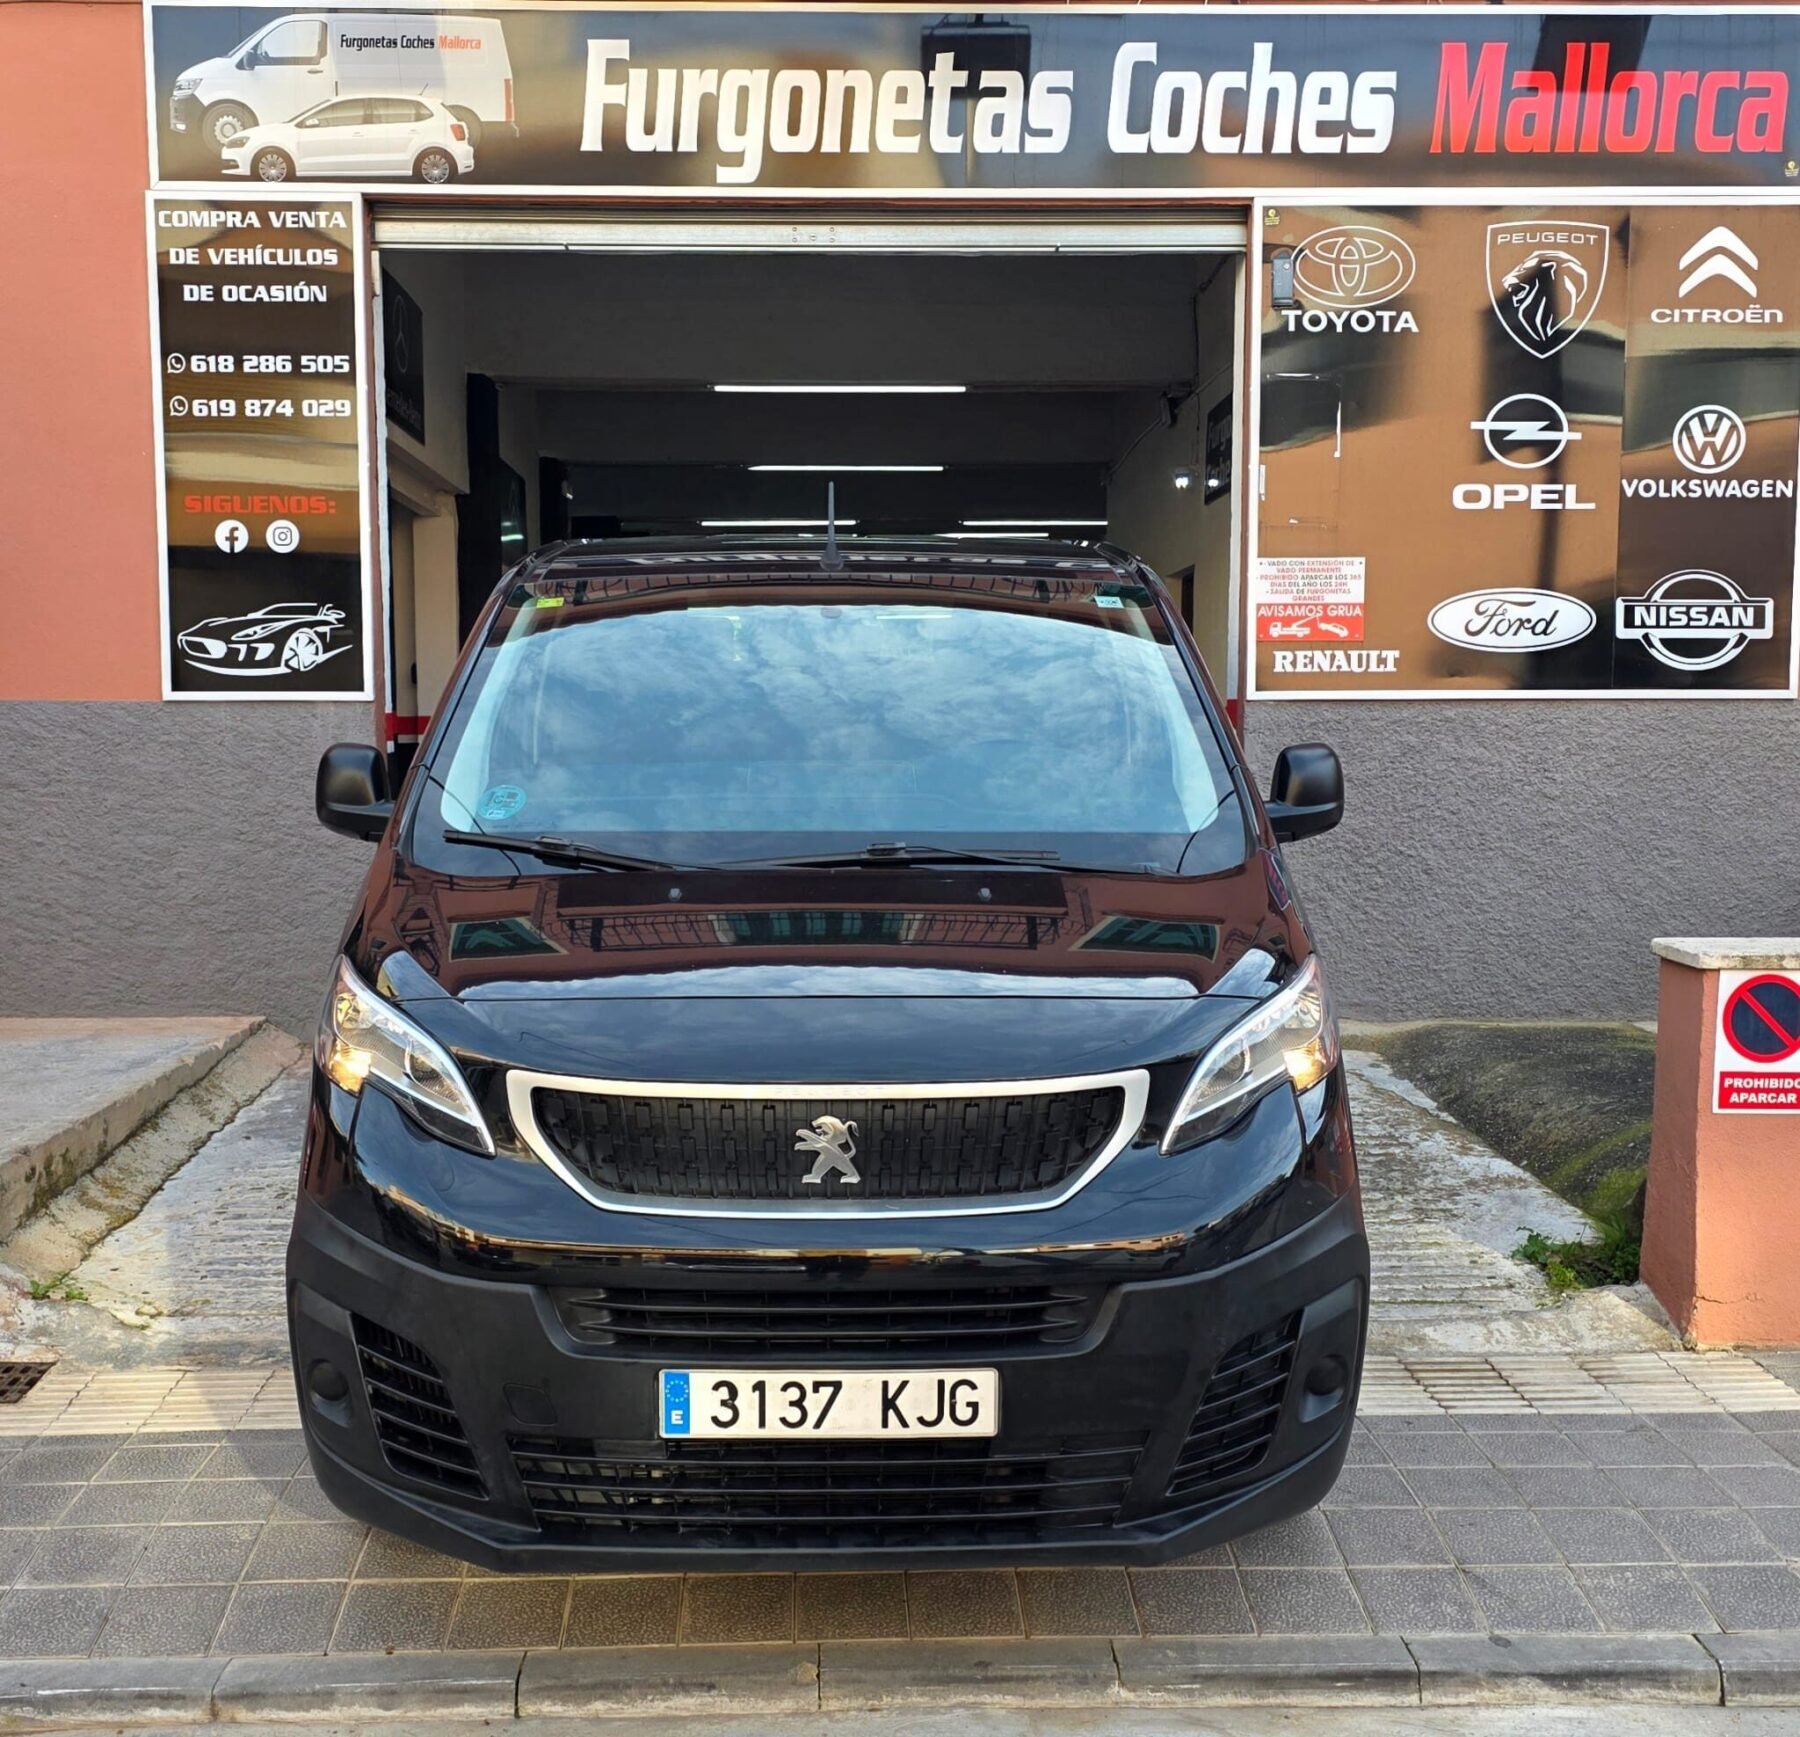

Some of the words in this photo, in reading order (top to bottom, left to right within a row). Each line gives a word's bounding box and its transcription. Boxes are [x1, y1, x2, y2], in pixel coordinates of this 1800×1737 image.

[340, 34, 398, 51] Furgonetas
[400, 35, 435, 49] Coches
[438, 35, 482, 49] Mallorca
[580, 38, 1074, 184] Furgonetas
[1107, 42, 1397, 154] Coches
[1429, 41, 1788, 154] Mallorca
[158, 210, 261, 229] COMPRA
[268, 210, 347, 228] VENTA
[1497, 231, 1599, 246] PEUGEOT
[169, 248, 199, 265] DE
[207, 244, 338, 265] VEHÍCULOS
[183, 284, 214, 302] DE
[222, 281, 327, 302] OCASIÓN
[1281, 309, 1419, 333] TOYOTA
[190, 355, 234, 373] 618
[243, 355, 292, 373] 286
[301, 355, 350, 373] 505
[192, 399, 236, 417] 619
[244, 399, 294, 417] 874
[302, 399, 352, 417] 029
[1452, 483, 1596, 510] OPEL
[1621, 478, 1794, 499] VOLKSWAGEN
[184, 495, 337, 514] SIGUENOS:
[1257, 605, 1324, 617] AVISAMOS
[1327, 605, 1362, 617] GRUA
[1464, 599, 1557, 637] Ford
[1633, 605, 1755, 628] NISSAN
[1273, 650, 1400, 673] RENAULT
[1729, 1092, 1798, 1104] APARCAR
[671, 1410, 684, 1424] E
[710, 1380, 843, 1430] 3137
[881, 1379, 980, 1429] KJG
